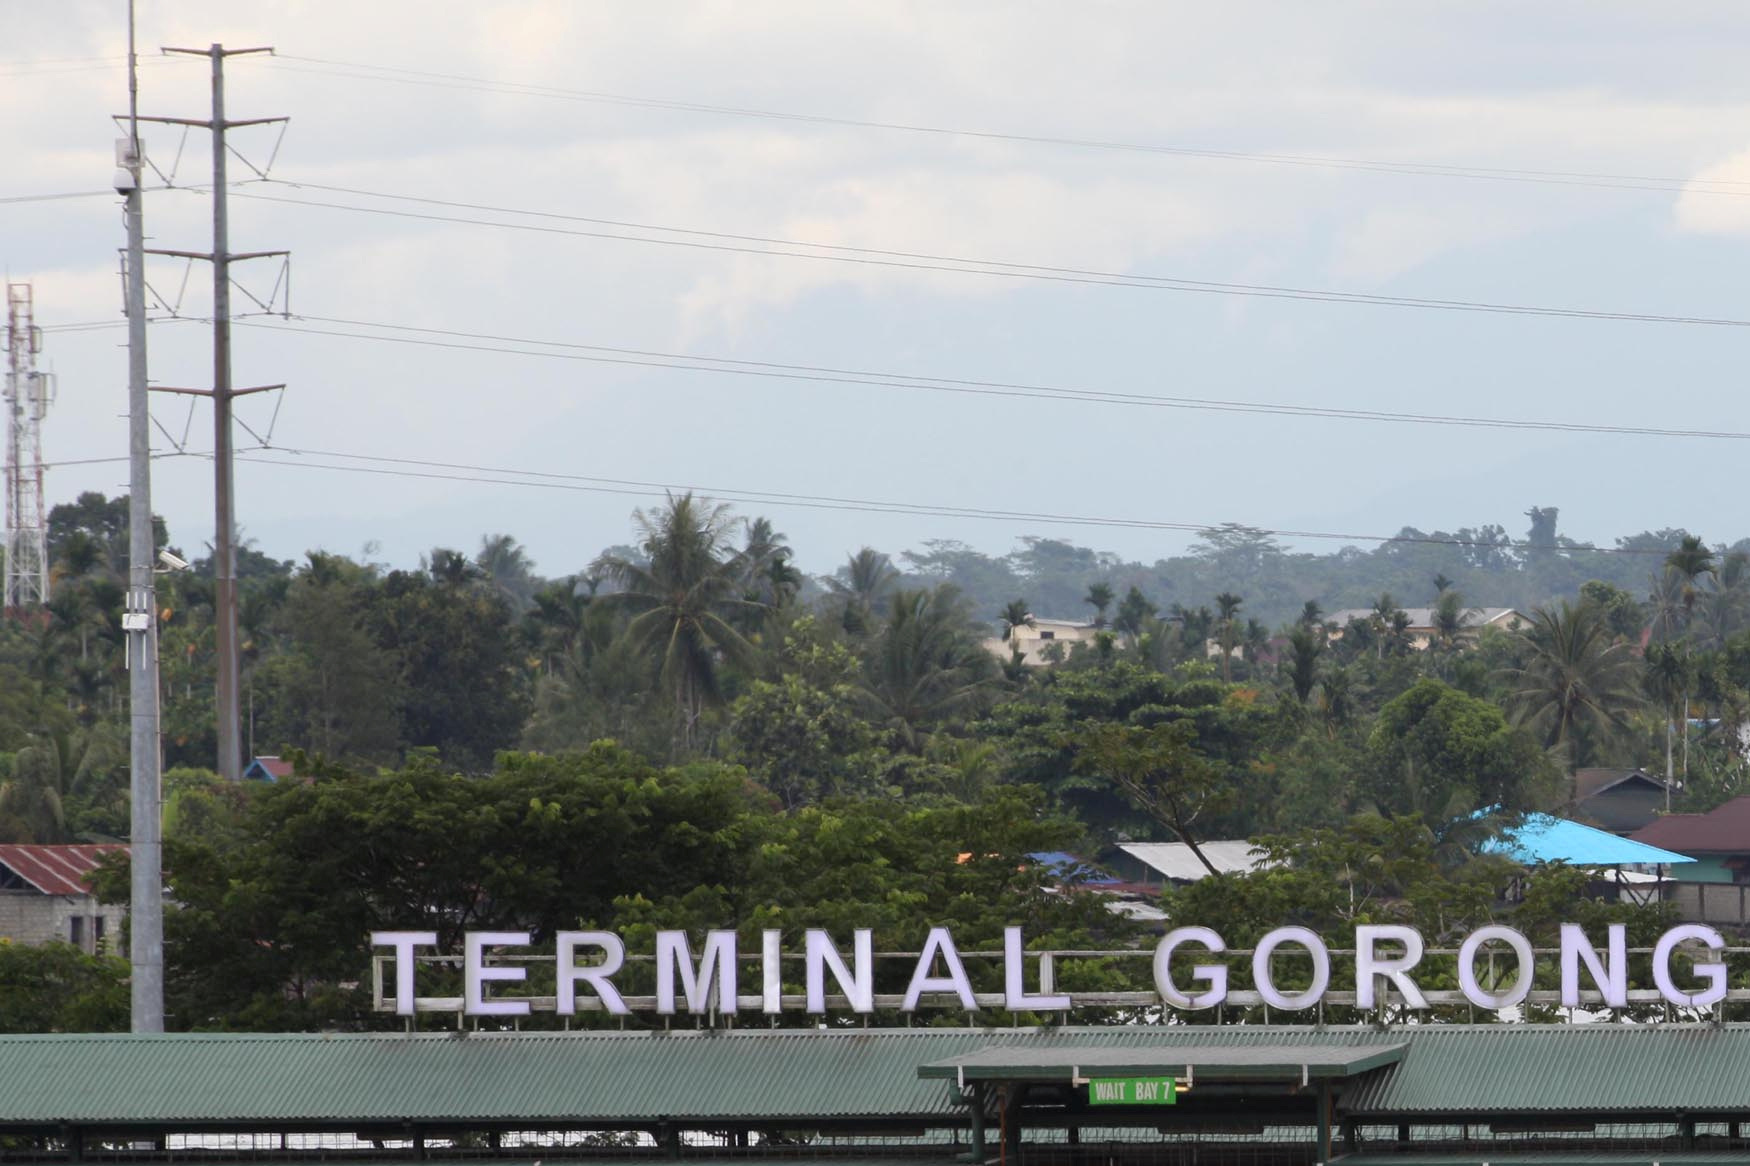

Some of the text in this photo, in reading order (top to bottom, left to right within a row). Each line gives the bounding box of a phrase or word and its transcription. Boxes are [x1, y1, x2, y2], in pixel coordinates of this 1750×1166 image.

[371, 926, 1071, 1016] TERMINAL
[1096, 1082, 1170, 1100] WAIT BAY 7
